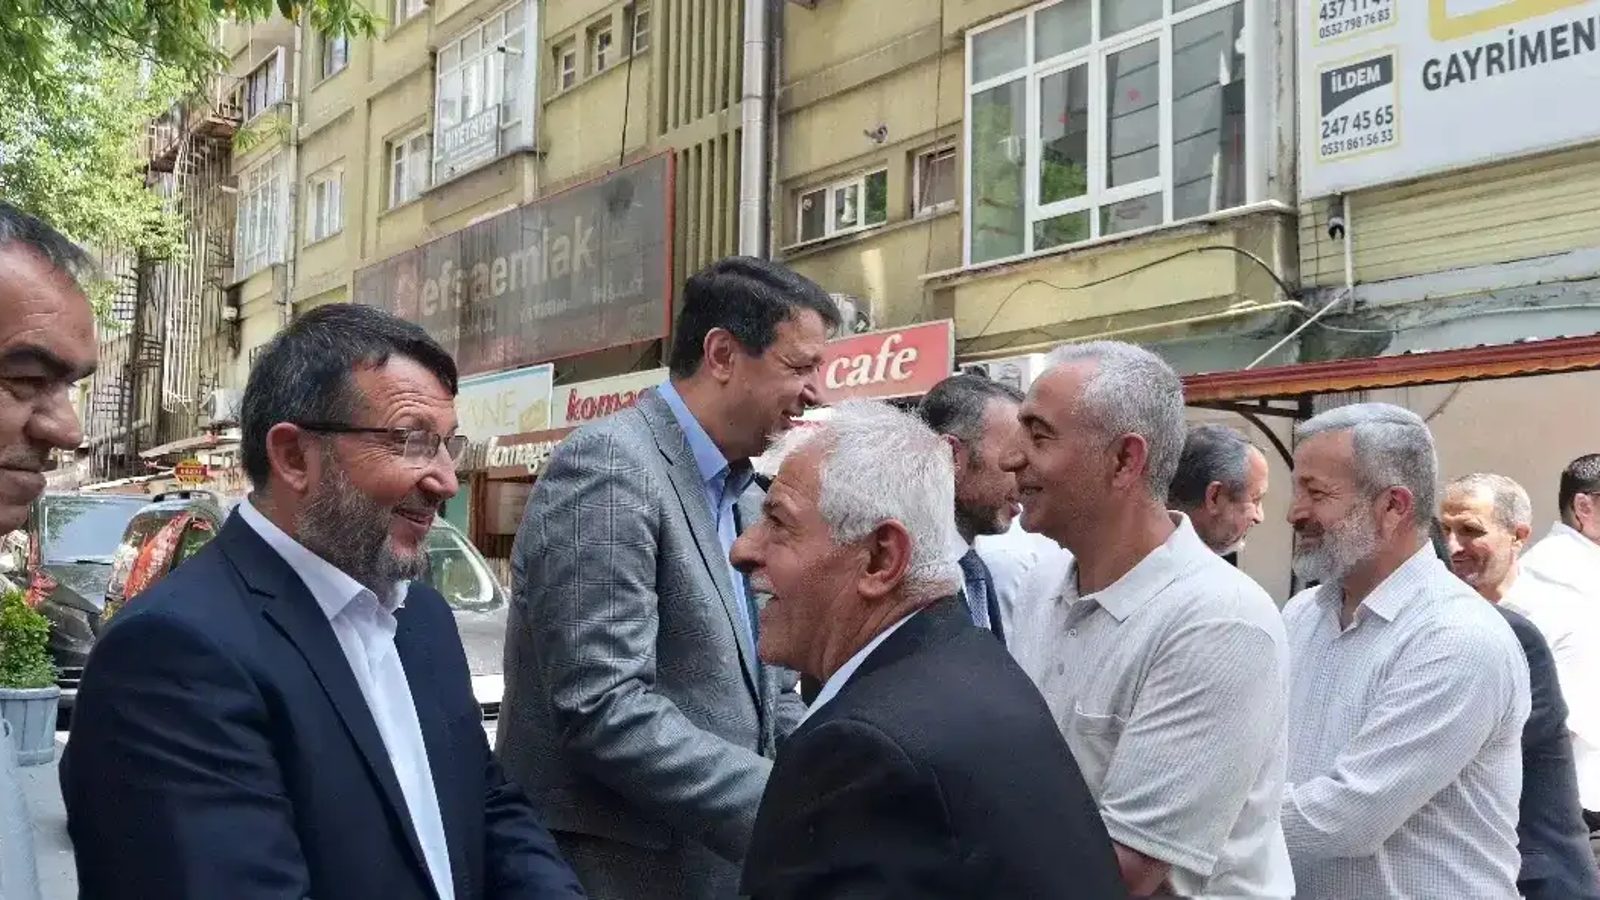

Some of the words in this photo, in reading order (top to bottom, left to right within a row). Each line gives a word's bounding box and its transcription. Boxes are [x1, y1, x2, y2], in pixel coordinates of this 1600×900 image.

[1319, 0, 1346, 20] 437
[1319, 22, 1342, 39] 0532
[1344, 15, 1361, 31] 798
[1363, 11, 1376, 26] 76
[1377, 7, 1391, 22] 83
[1422, 14, 1600, 91] GAYRİMEN
[1331, 63, 1380, 93] İLDEM
[1321, 115, 1349, 139] 247
[1353, 110, 1371, 132] 45
[1375, 104, 1393, 126] 65
[1321, 140, 1345, 156] 0531
[1347, 136, 1364, 150] 861
[1366, 132, 1379, 146] 56
[1381, 128, 1393, 142] 33
[825, 333, 919, 390] cafe
